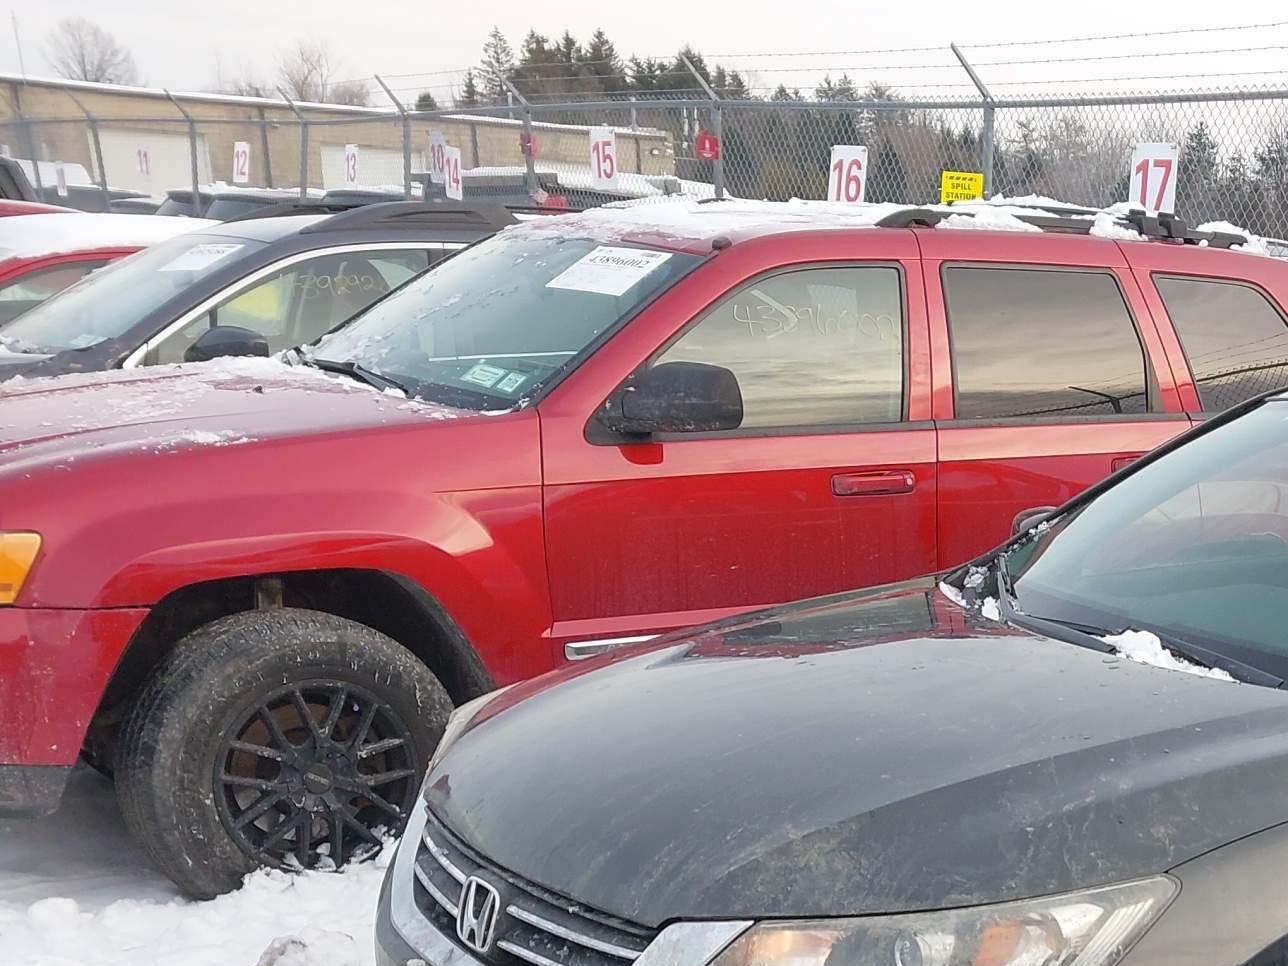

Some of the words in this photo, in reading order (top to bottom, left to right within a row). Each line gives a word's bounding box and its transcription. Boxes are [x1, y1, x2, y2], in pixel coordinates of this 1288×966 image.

[137, 149, 150, 176] 11
[234, 150, 248, 176] 12
[346, 153, 357, 182] 13
[446, 158, 460, 190] 14
[592, 140, 614, 179] 15
[832, 158, 862, 202] 16
[950, 182, 972, 191] SPILL
[1135, 158, 1173, 211] 17
[945, 191, 977, 200] STATION
